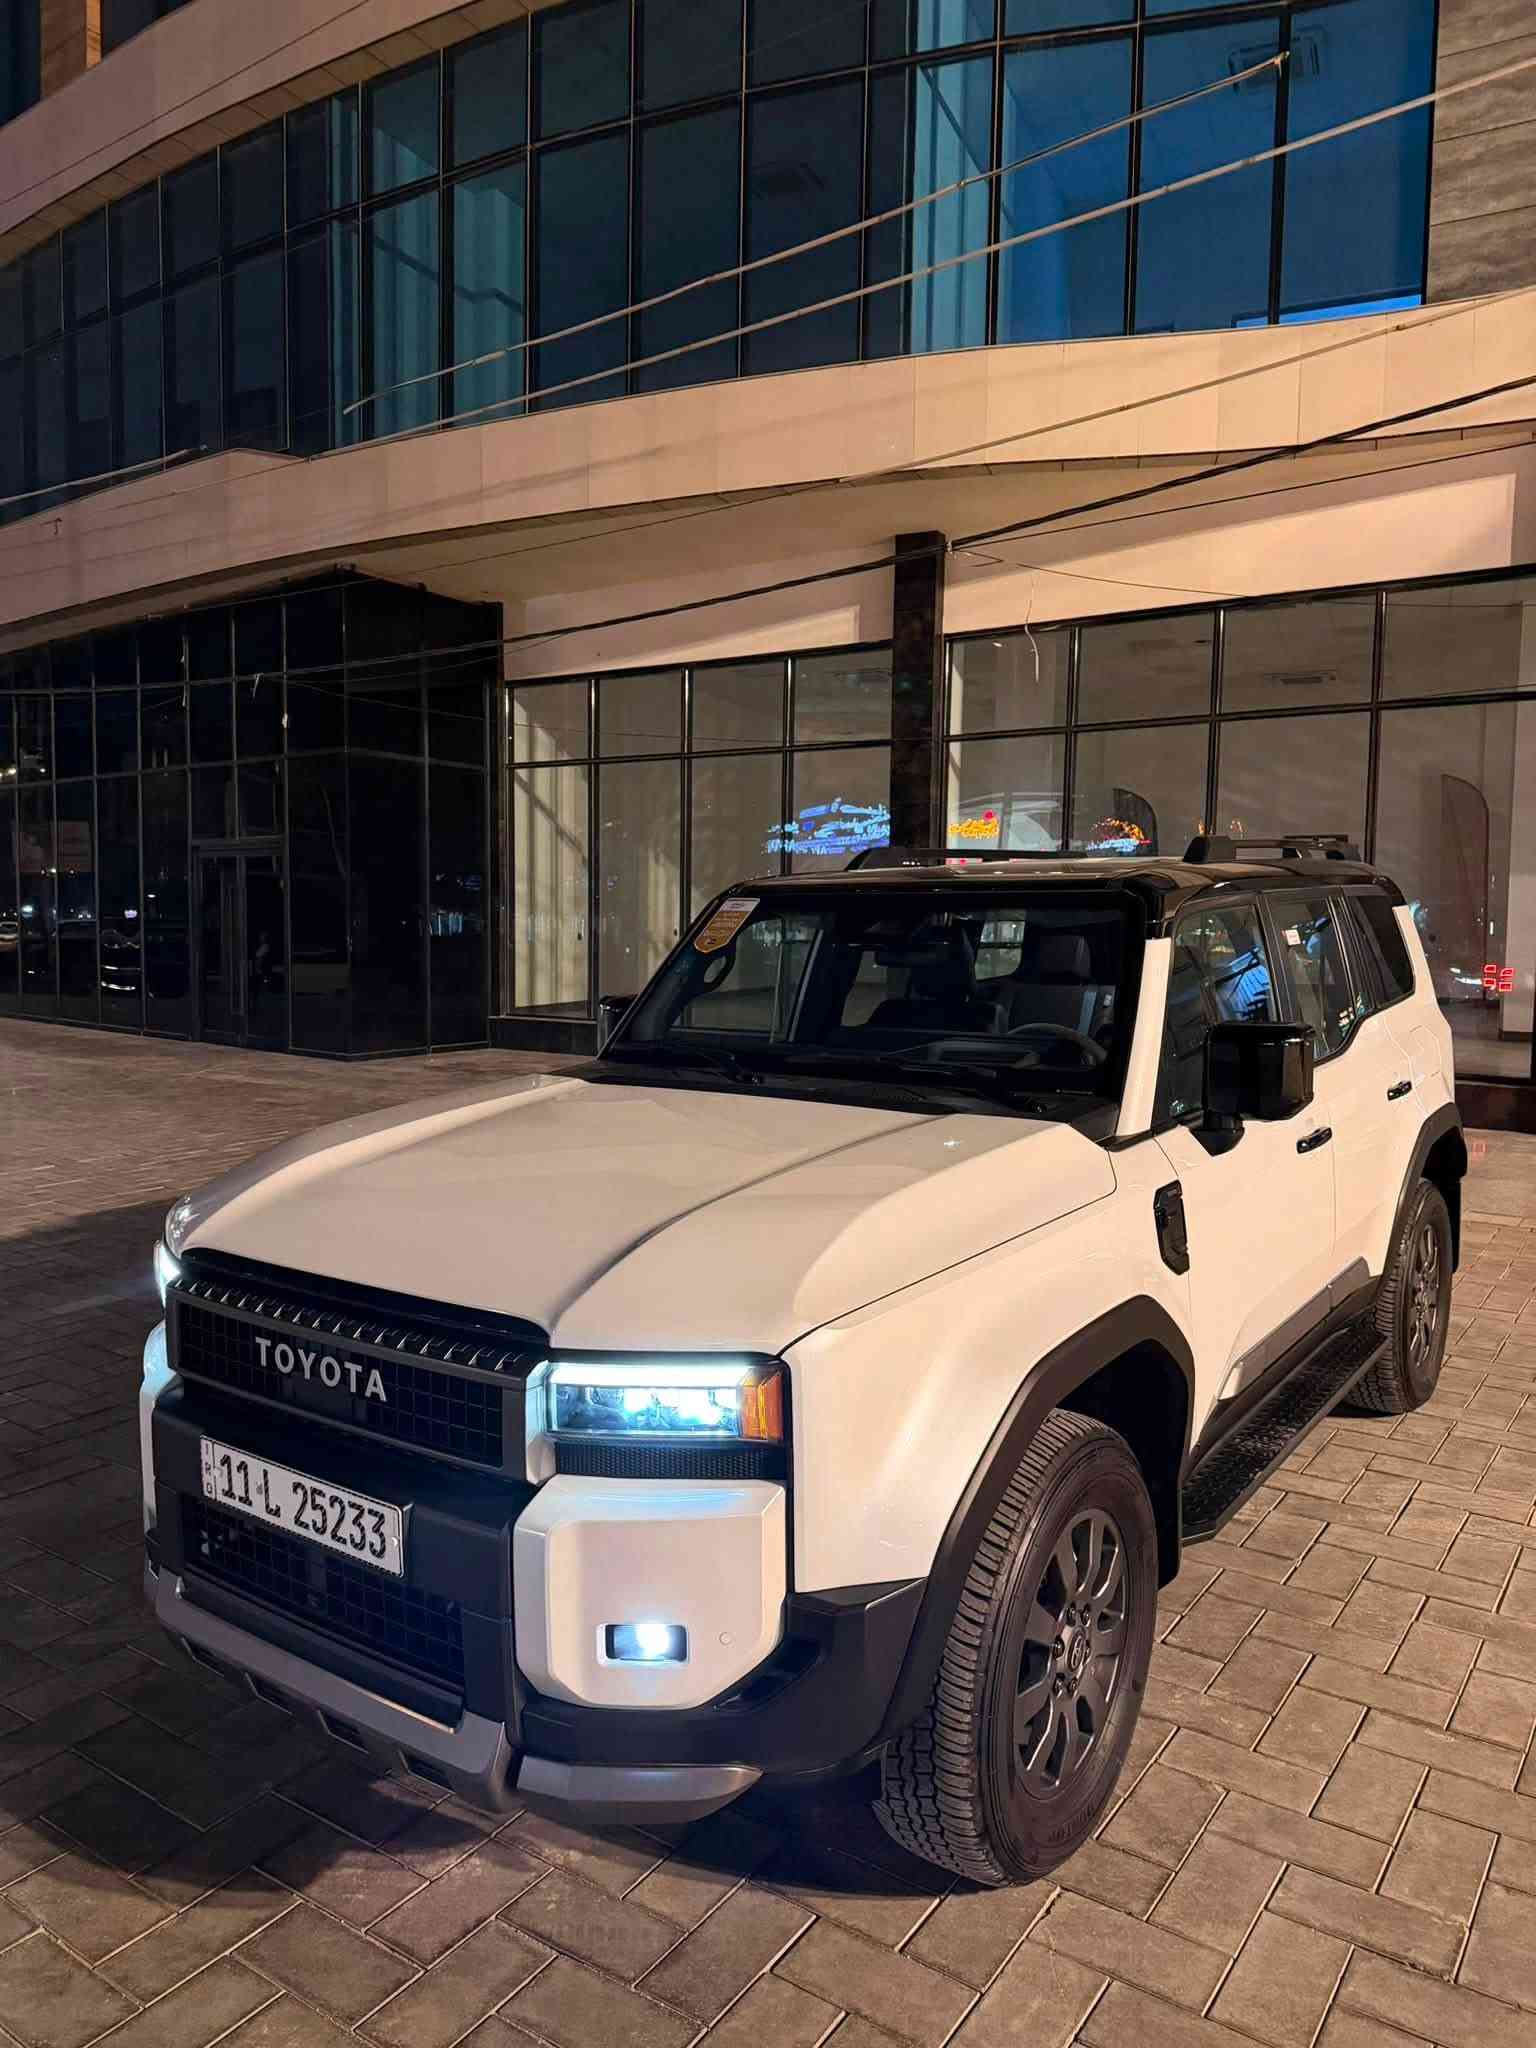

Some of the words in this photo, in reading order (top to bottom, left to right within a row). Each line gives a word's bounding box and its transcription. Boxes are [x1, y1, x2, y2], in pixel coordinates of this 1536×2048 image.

[256, 1337, 387, 1401] TOYOTA
[221, 1454, 253, 1506] 11
[292, 1482, 387, 1560] 25233
